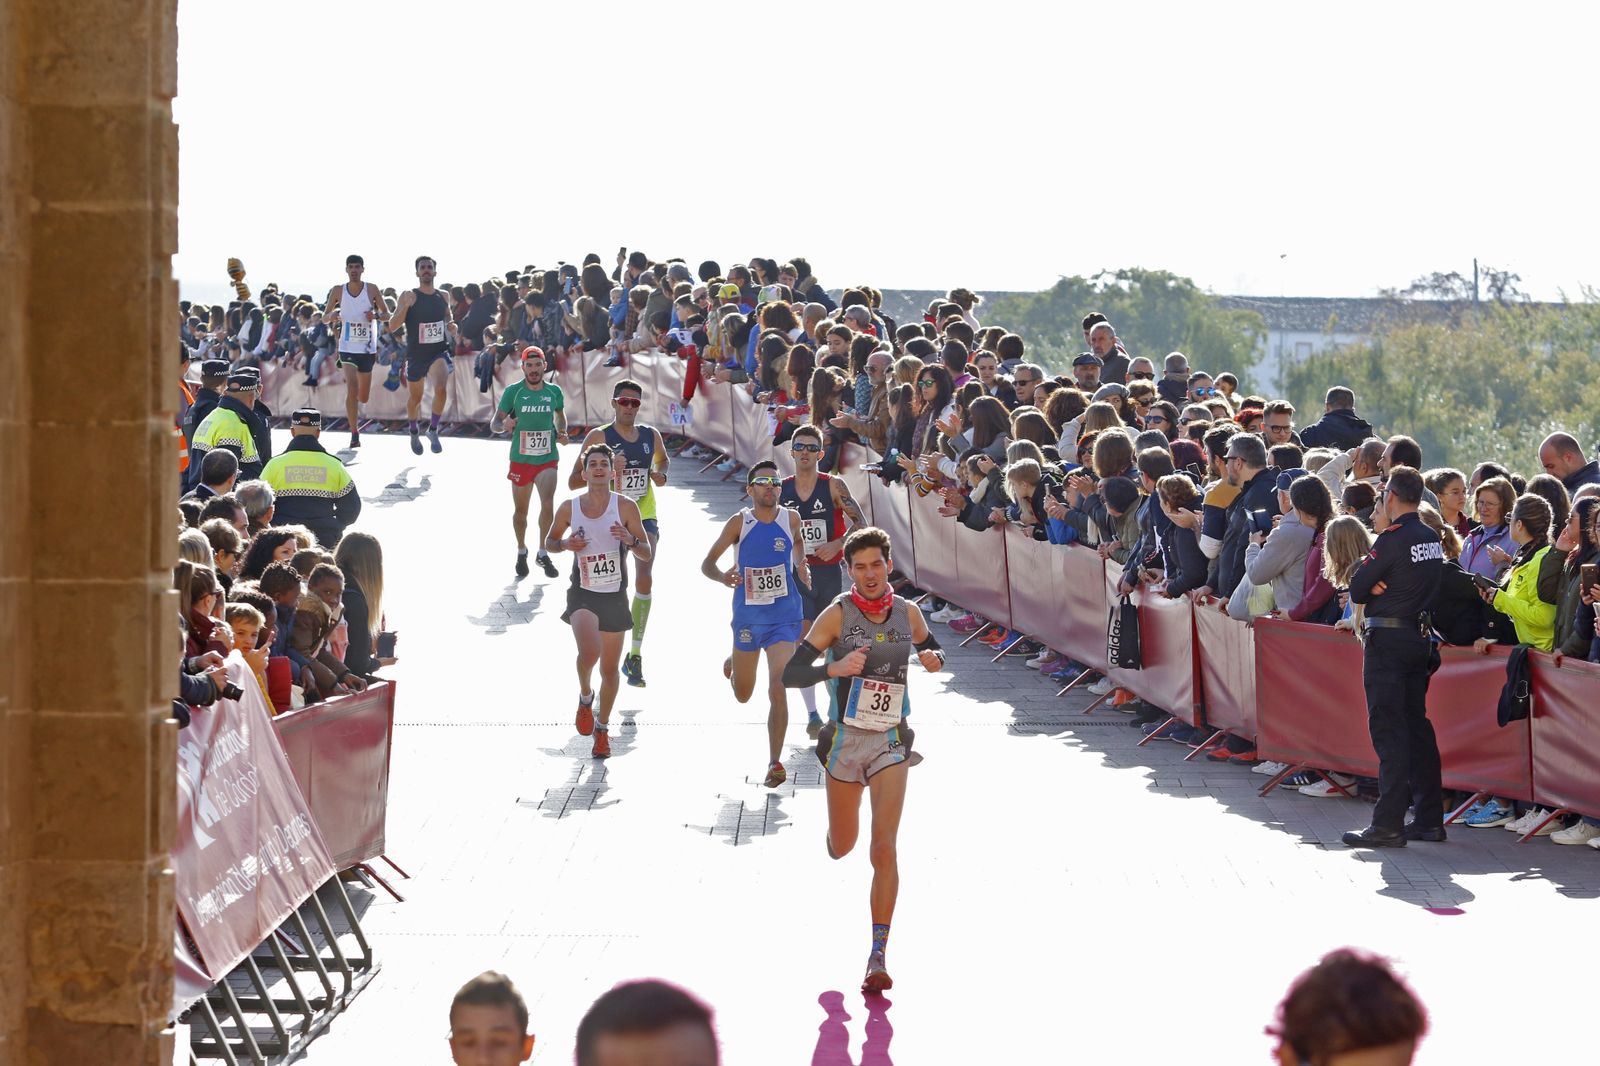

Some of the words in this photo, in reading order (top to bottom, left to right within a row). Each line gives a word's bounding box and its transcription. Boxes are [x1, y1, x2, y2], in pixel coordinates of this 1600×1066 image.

[352, 327, 367, 337] 136
[427, 327, 442, 337] 334
[530, 437, 548, 448] 370
[626, 475, 645, 488] 275
[593, 560, 616, 575] 443
[758, 574, 782, 590] 386
[1109, 619, 1121, 664] adidas
[870, 693, 892, 712] 38
[214, 786, 232, 817] de
